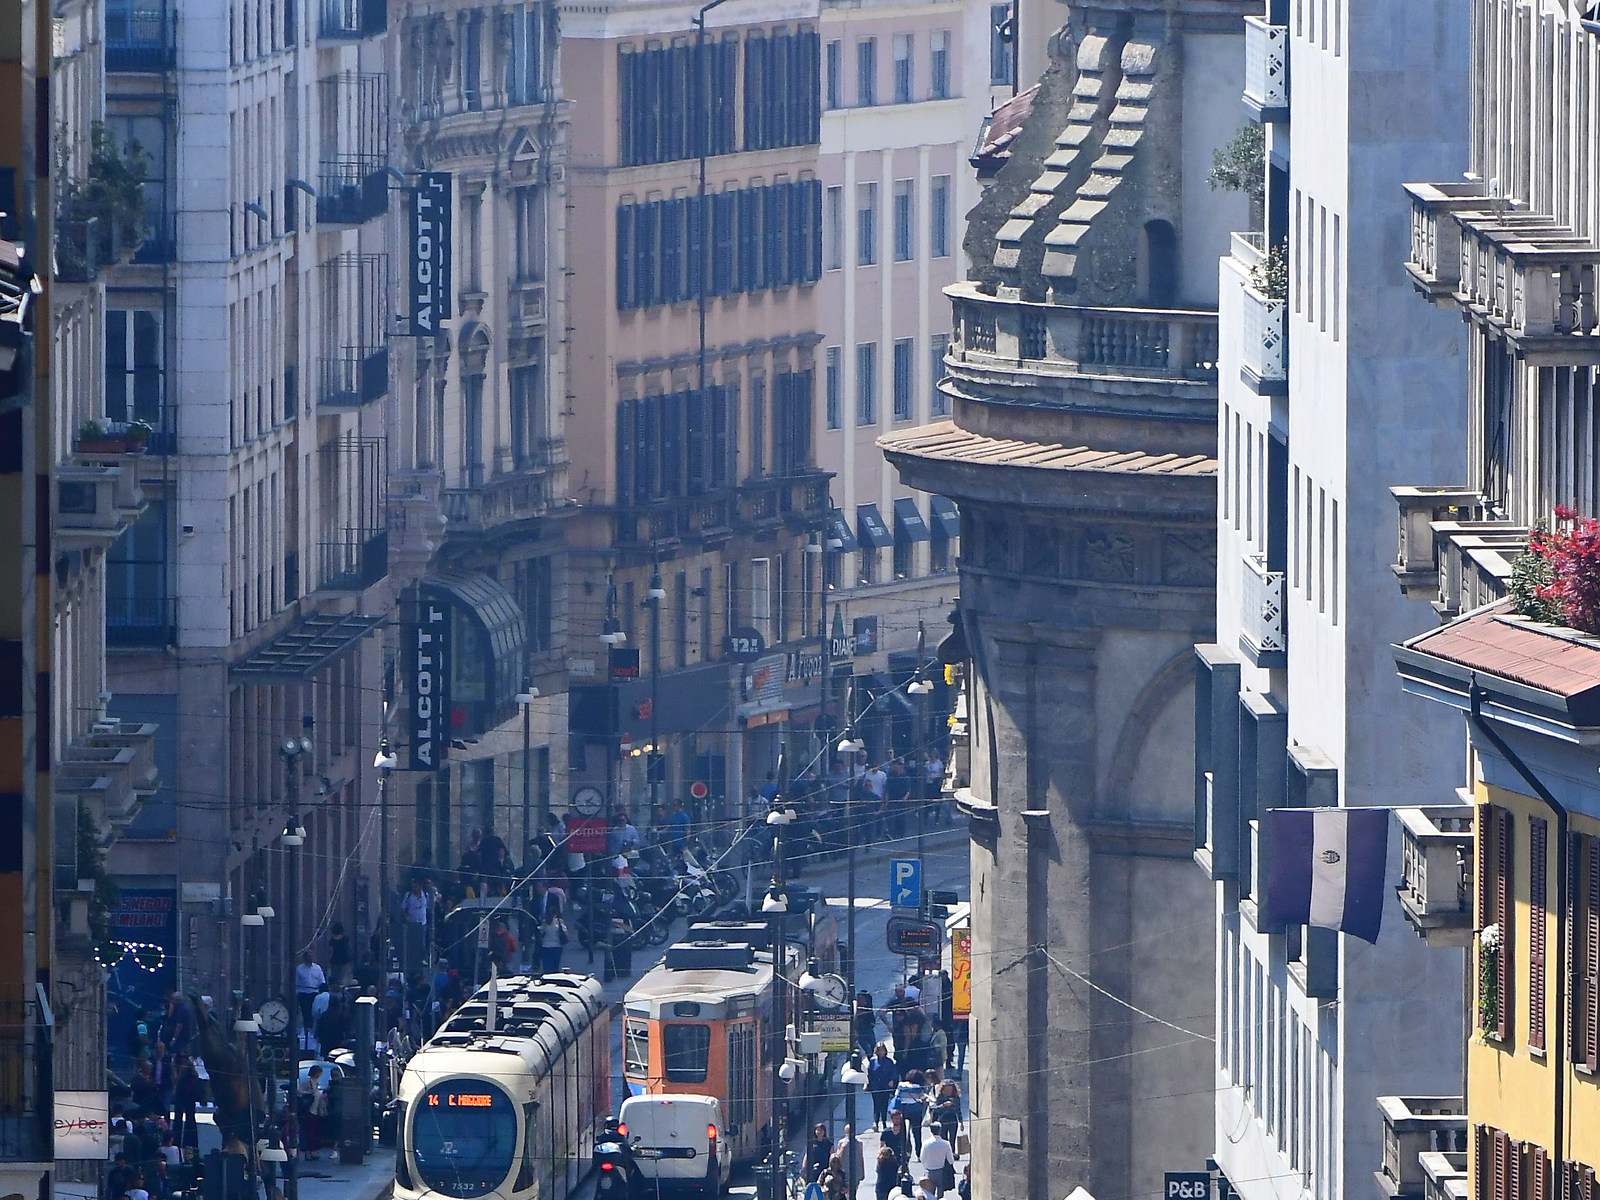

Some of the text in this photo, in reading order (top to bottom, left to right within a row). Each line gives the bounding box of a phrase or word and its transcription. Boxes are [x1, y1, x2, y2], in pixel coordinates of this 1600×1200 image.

[418, 193, 431, 330] ALCOTT
[417, 628, 431, 765] ALCOTT
[896, 862, 914, 885] P
[451, 1182, 475, 1191] 7532
[1168, 1181, 1206, 1199] P&B
